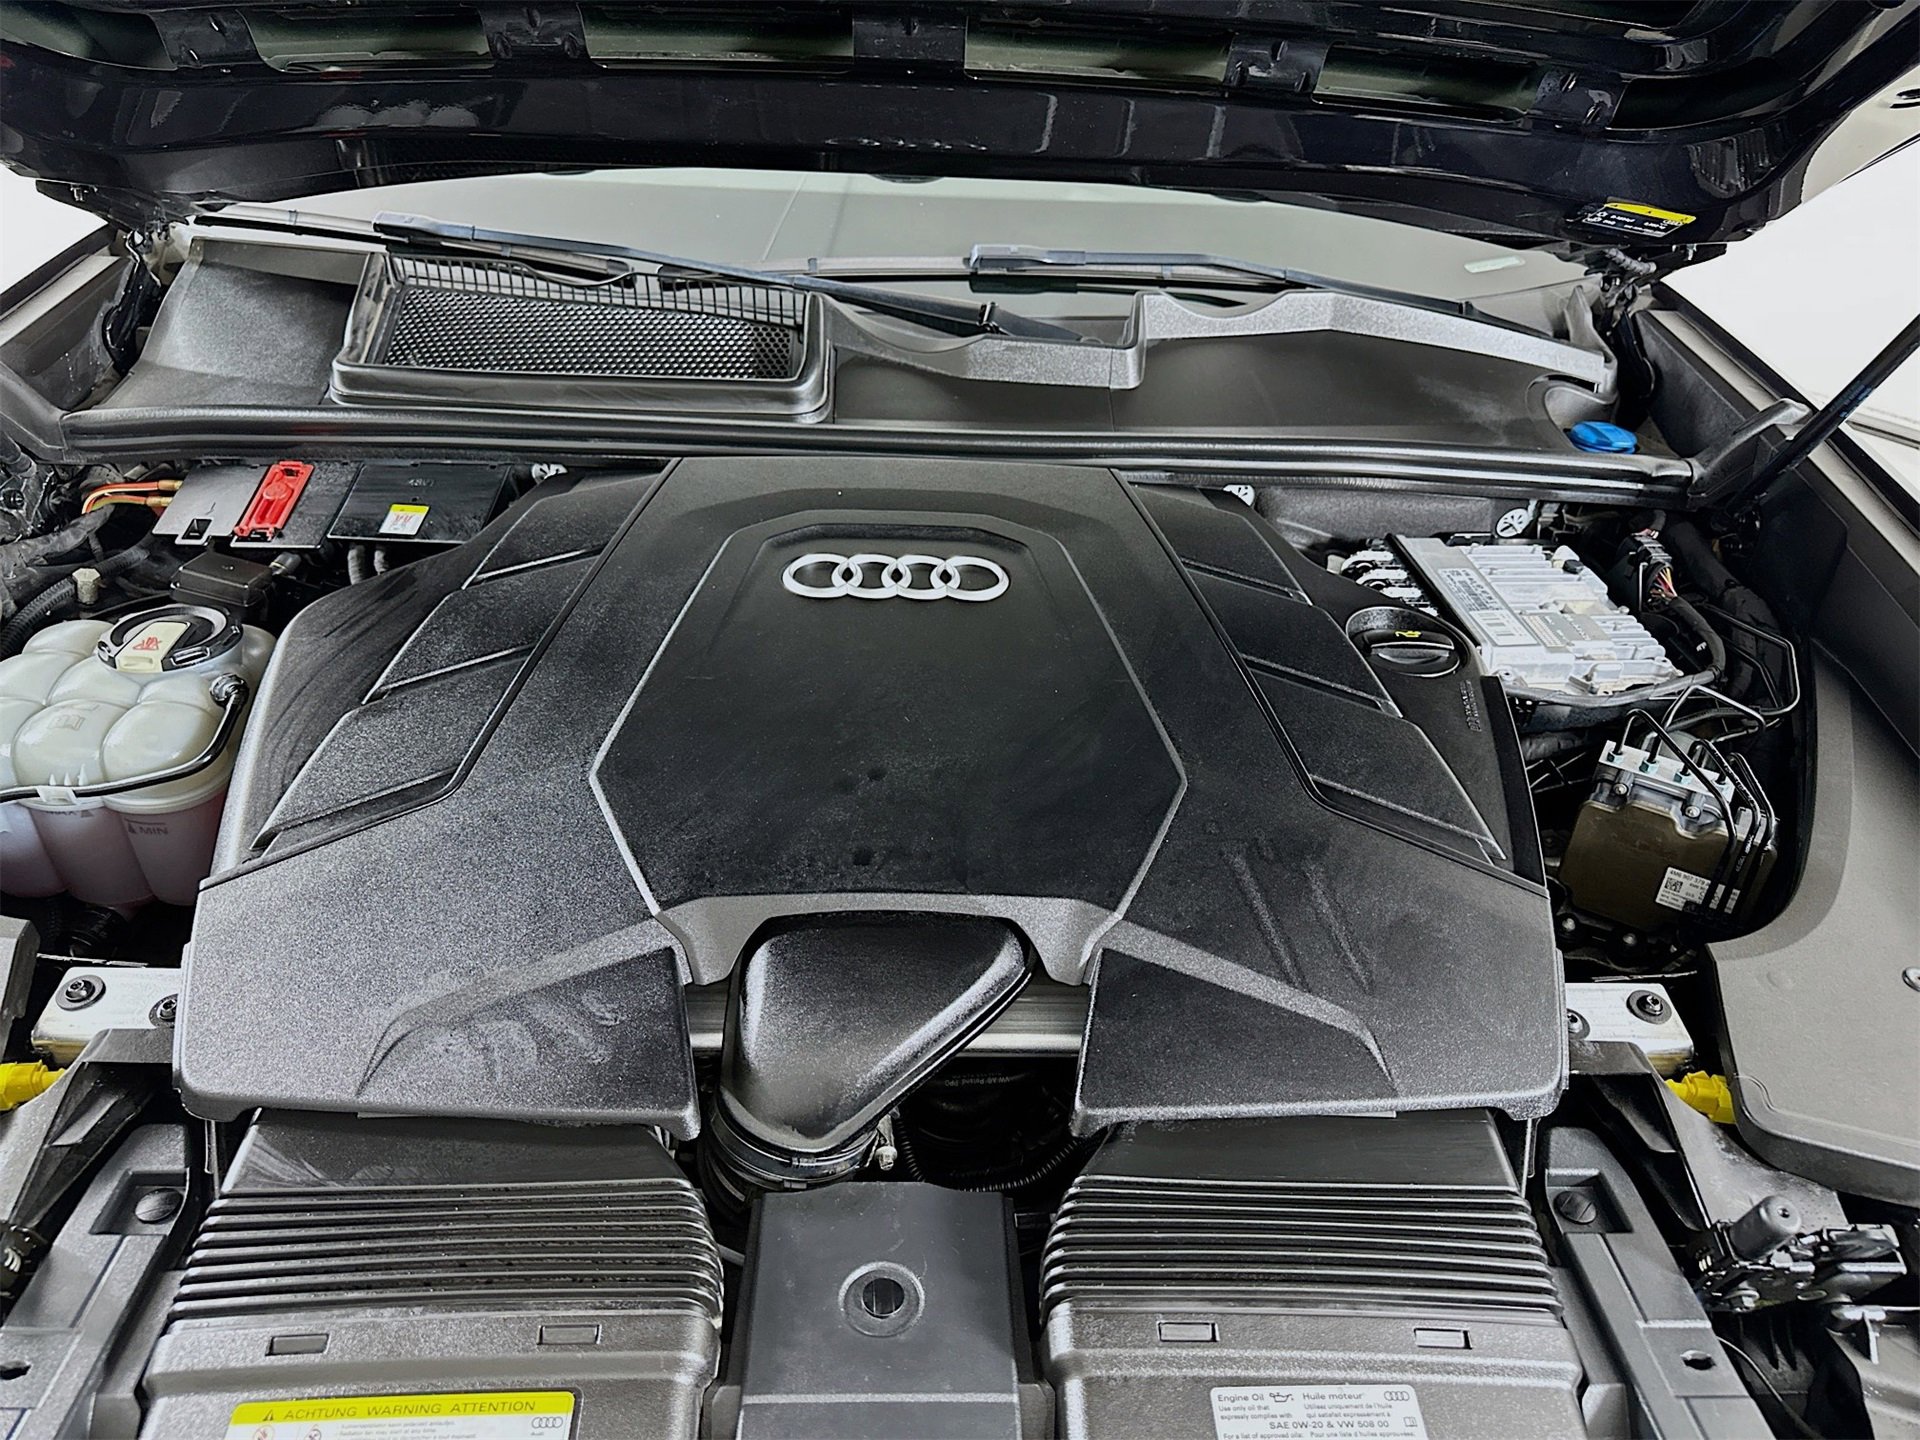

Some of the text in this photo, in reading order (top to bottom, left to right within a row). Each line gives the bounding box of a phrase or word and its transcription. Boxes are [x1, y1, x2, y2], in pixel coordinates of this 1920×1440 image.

[139, 826, 169, 835] MIN
[1217, 1393, 1264, 1403] Engine Oil
[1303, 1392, 1326, 1400] Huile
[284, 1401, 536, 1420] ACHTUNG WARNING ATTENTION
[1269, 1420, 1389, 1430] SAE 0W-20 & VW 508 00
[1223, 1432, 1234, 1440] For
[1251, 1431, 1258, 1439] of
